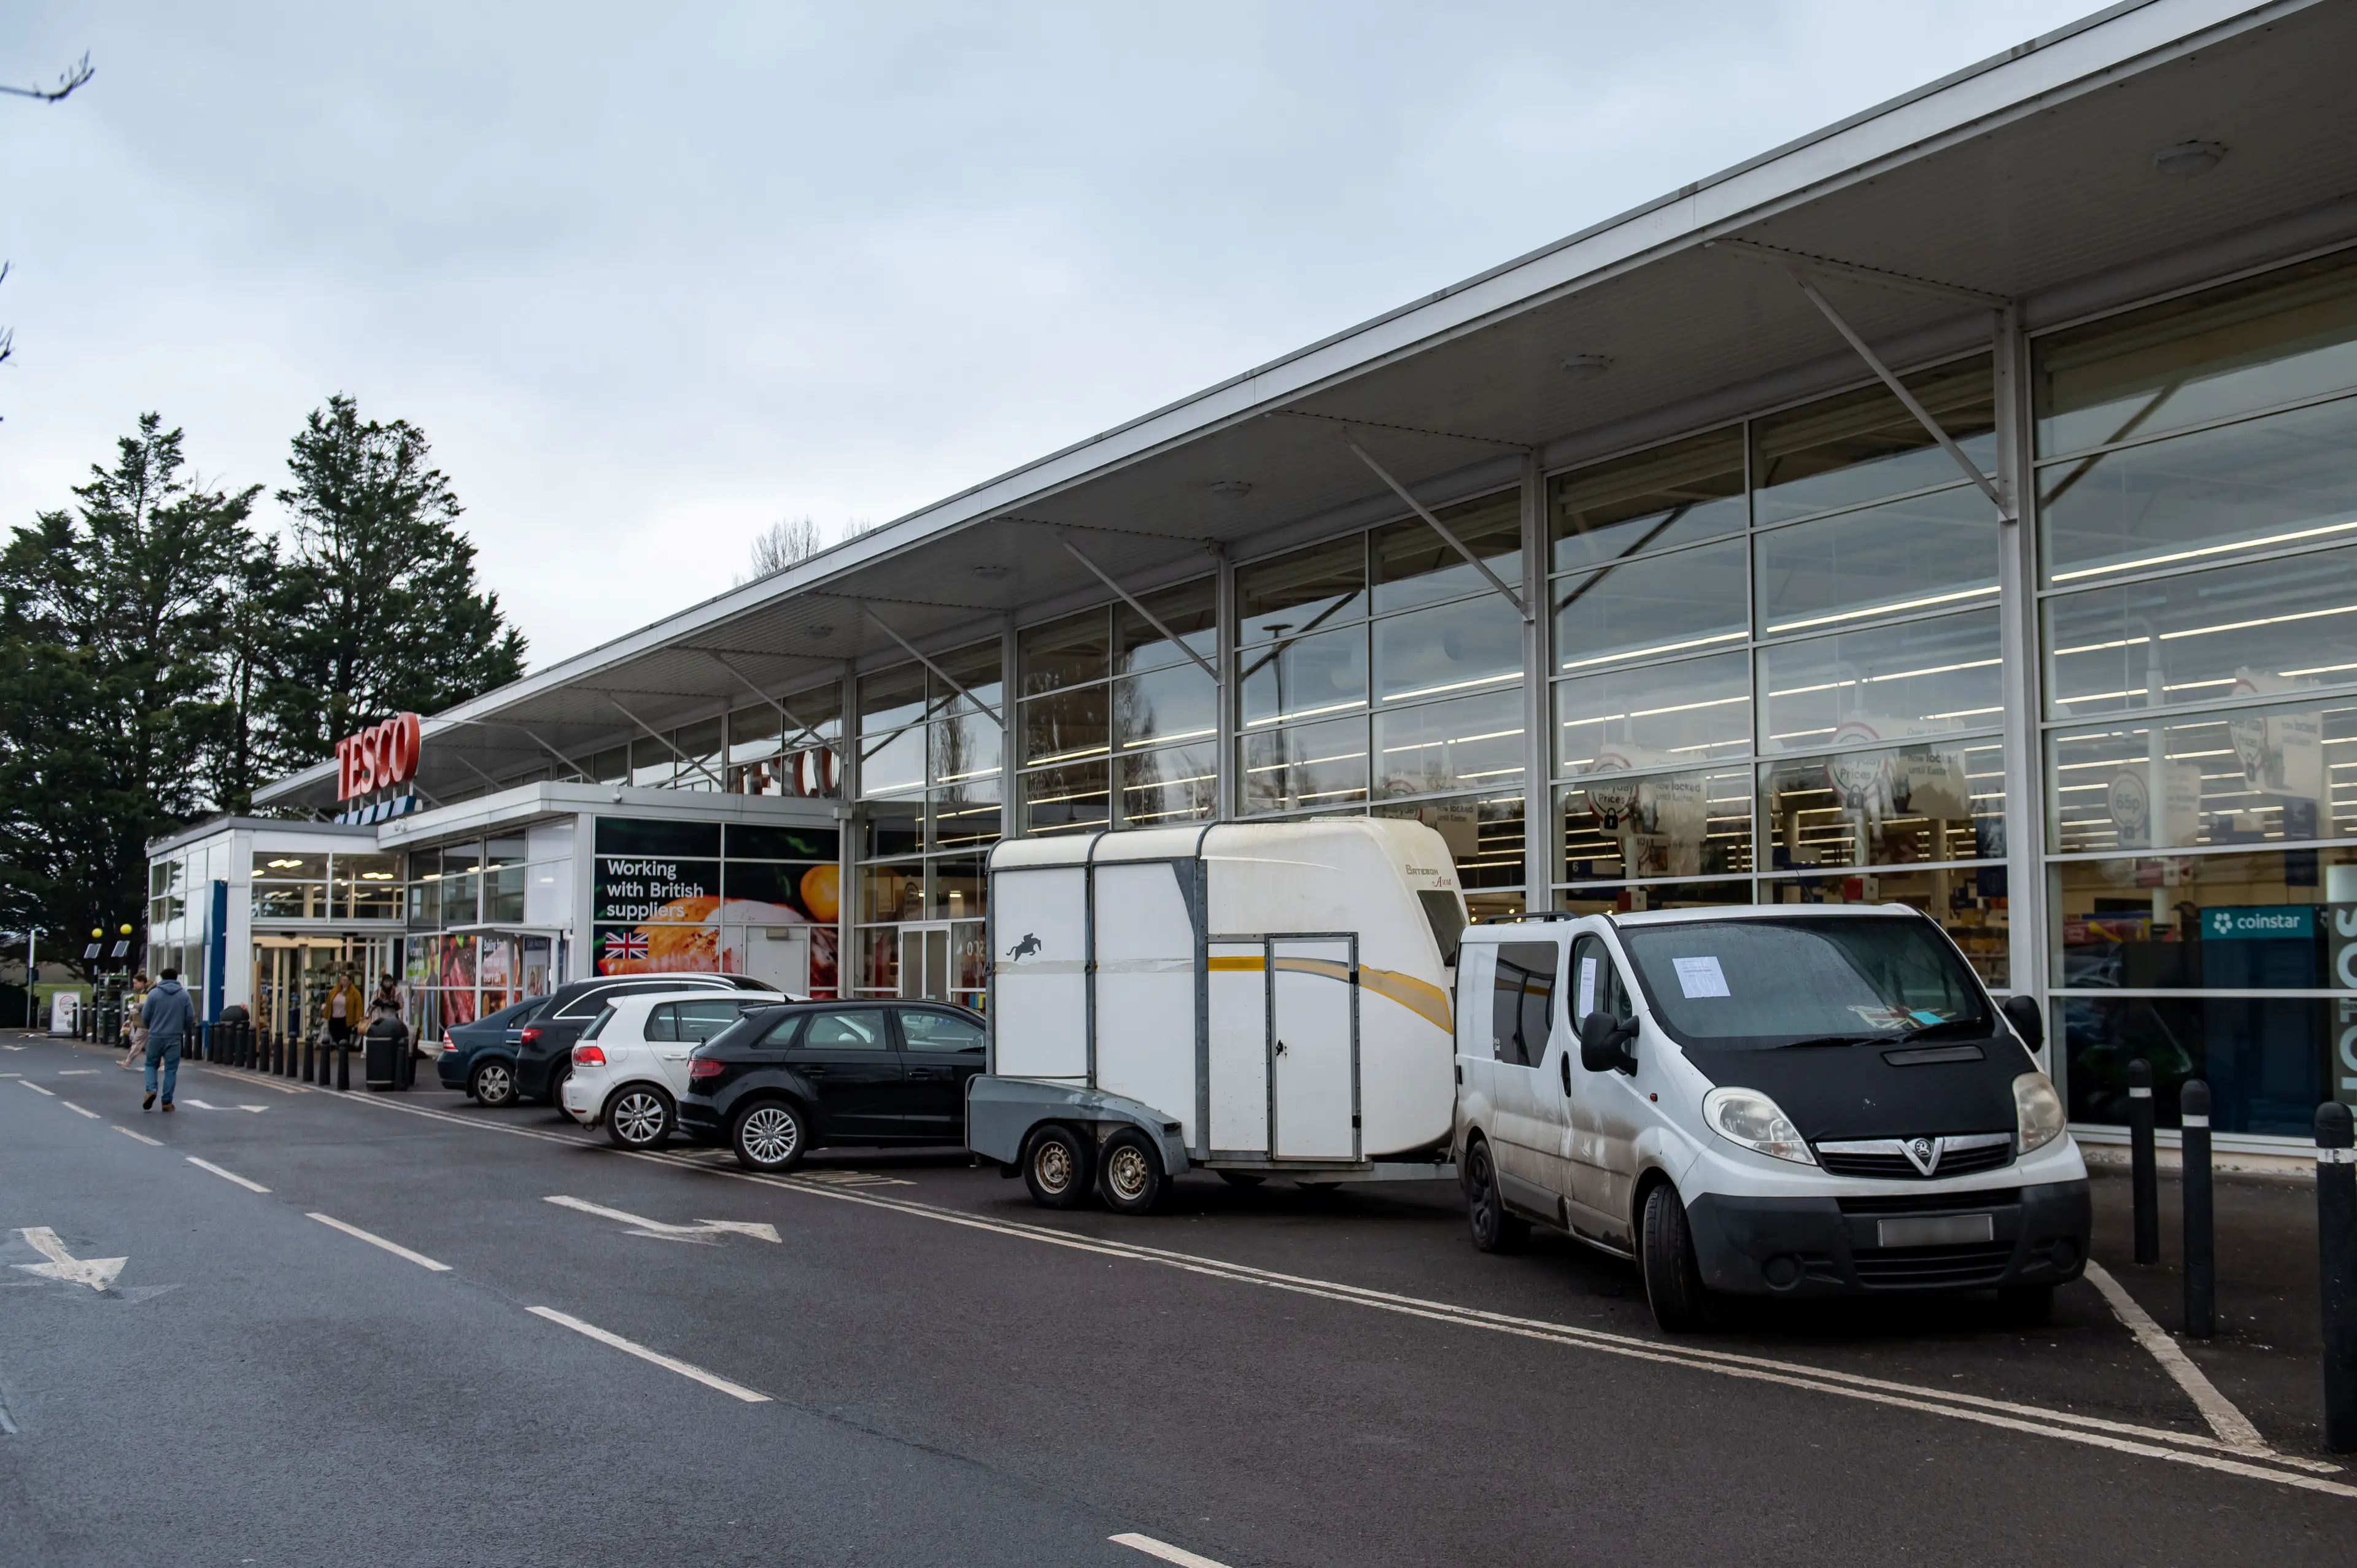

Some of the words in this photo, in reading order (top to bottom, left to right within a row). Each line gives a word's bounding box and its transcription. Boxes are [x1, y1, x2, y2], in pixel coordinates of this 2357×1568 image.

[336, 712, 420, 801] TESCO
[1840, 768, 1871, 779] Prices
[1671, 780, 1701, 792] locked
[1598, 793, 1625, 804] Prices
[2116, 794, 2140, 815] 65p
[1450, 805, 1474, 813] locked
[607, 860, 676, 879] Working
[607, 881, 643, 897] with
[650, 882, 703, 898] British
[606, 902, 685, 920] suppliers
[2237, 913, 2300, 929] coinstar
